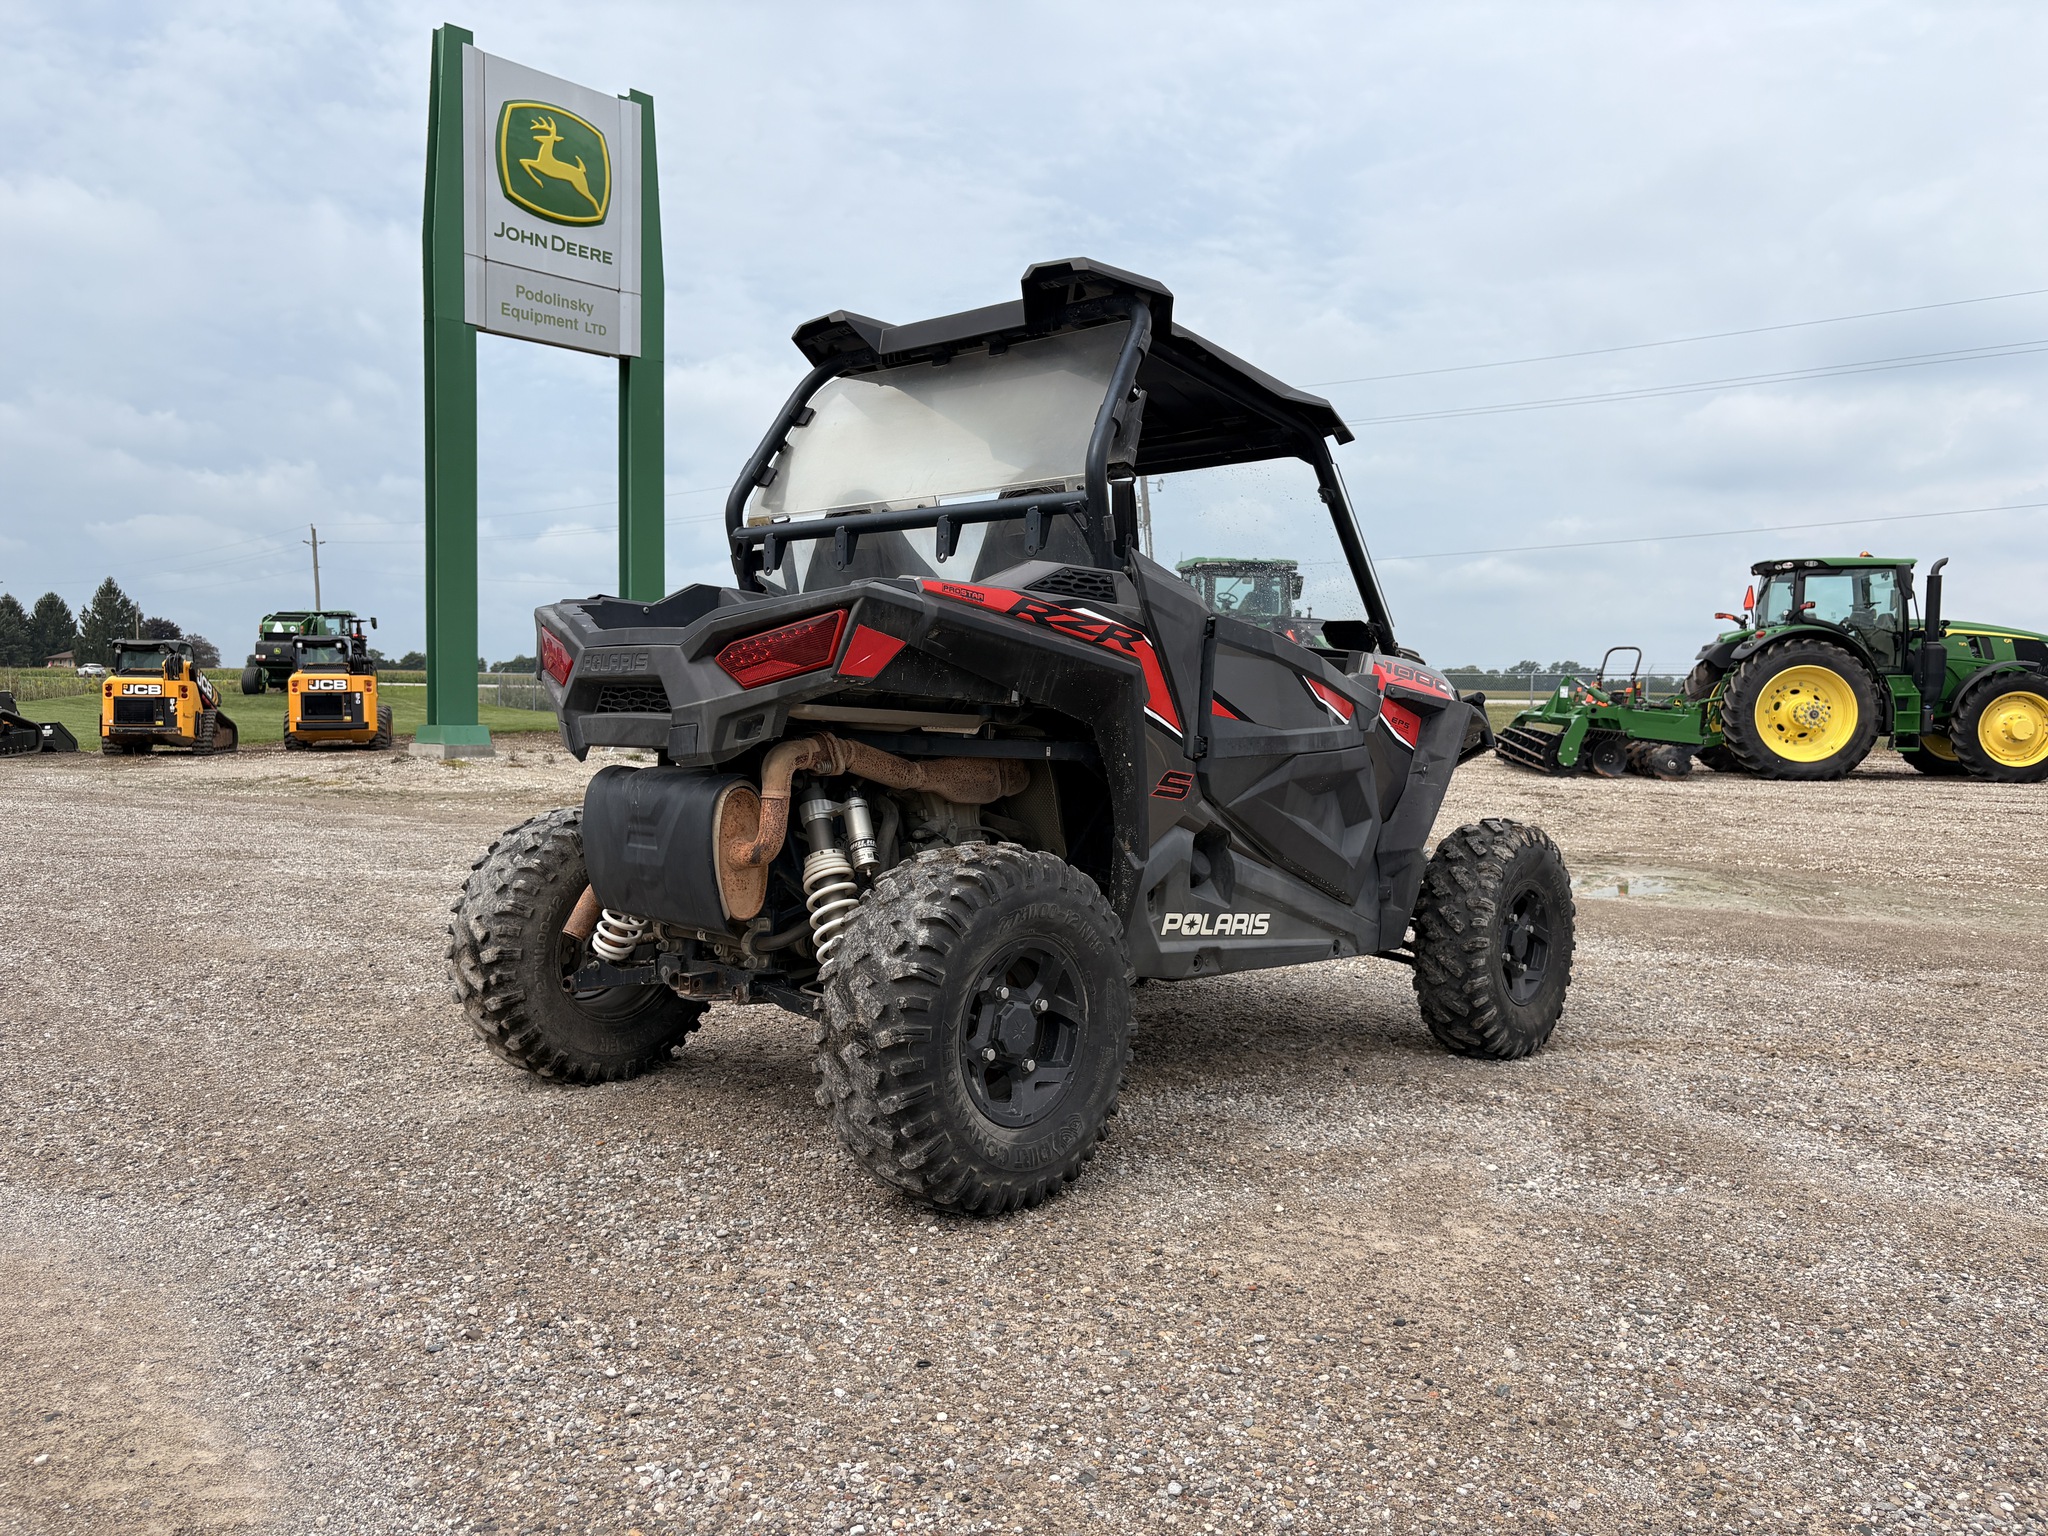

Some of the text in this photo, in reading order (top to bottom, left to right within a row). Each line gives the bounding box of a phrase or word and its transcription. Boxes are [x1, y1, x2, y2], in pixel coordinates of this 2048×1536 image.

[494, 222, 613, 265] JOHN DEERE
[516, 284, 594, 317] Podolinsky
[501, 302, 607, 336] Equipment LTD
[943, 585, 984, 601] PROSTAR
[1006, 597, 1144, 653] RZR
[582, 653, 649, 671] POLARIS
[123, 684, 162, 695] JCB
[197, 672, 213, 700] JCB
[309, 679, 347, 690] JCB
[1391, 717, 1410, 729] EPS
[1151, 770, 1194, 801] S
[1160, 912, 1271, 936] POLARIS
